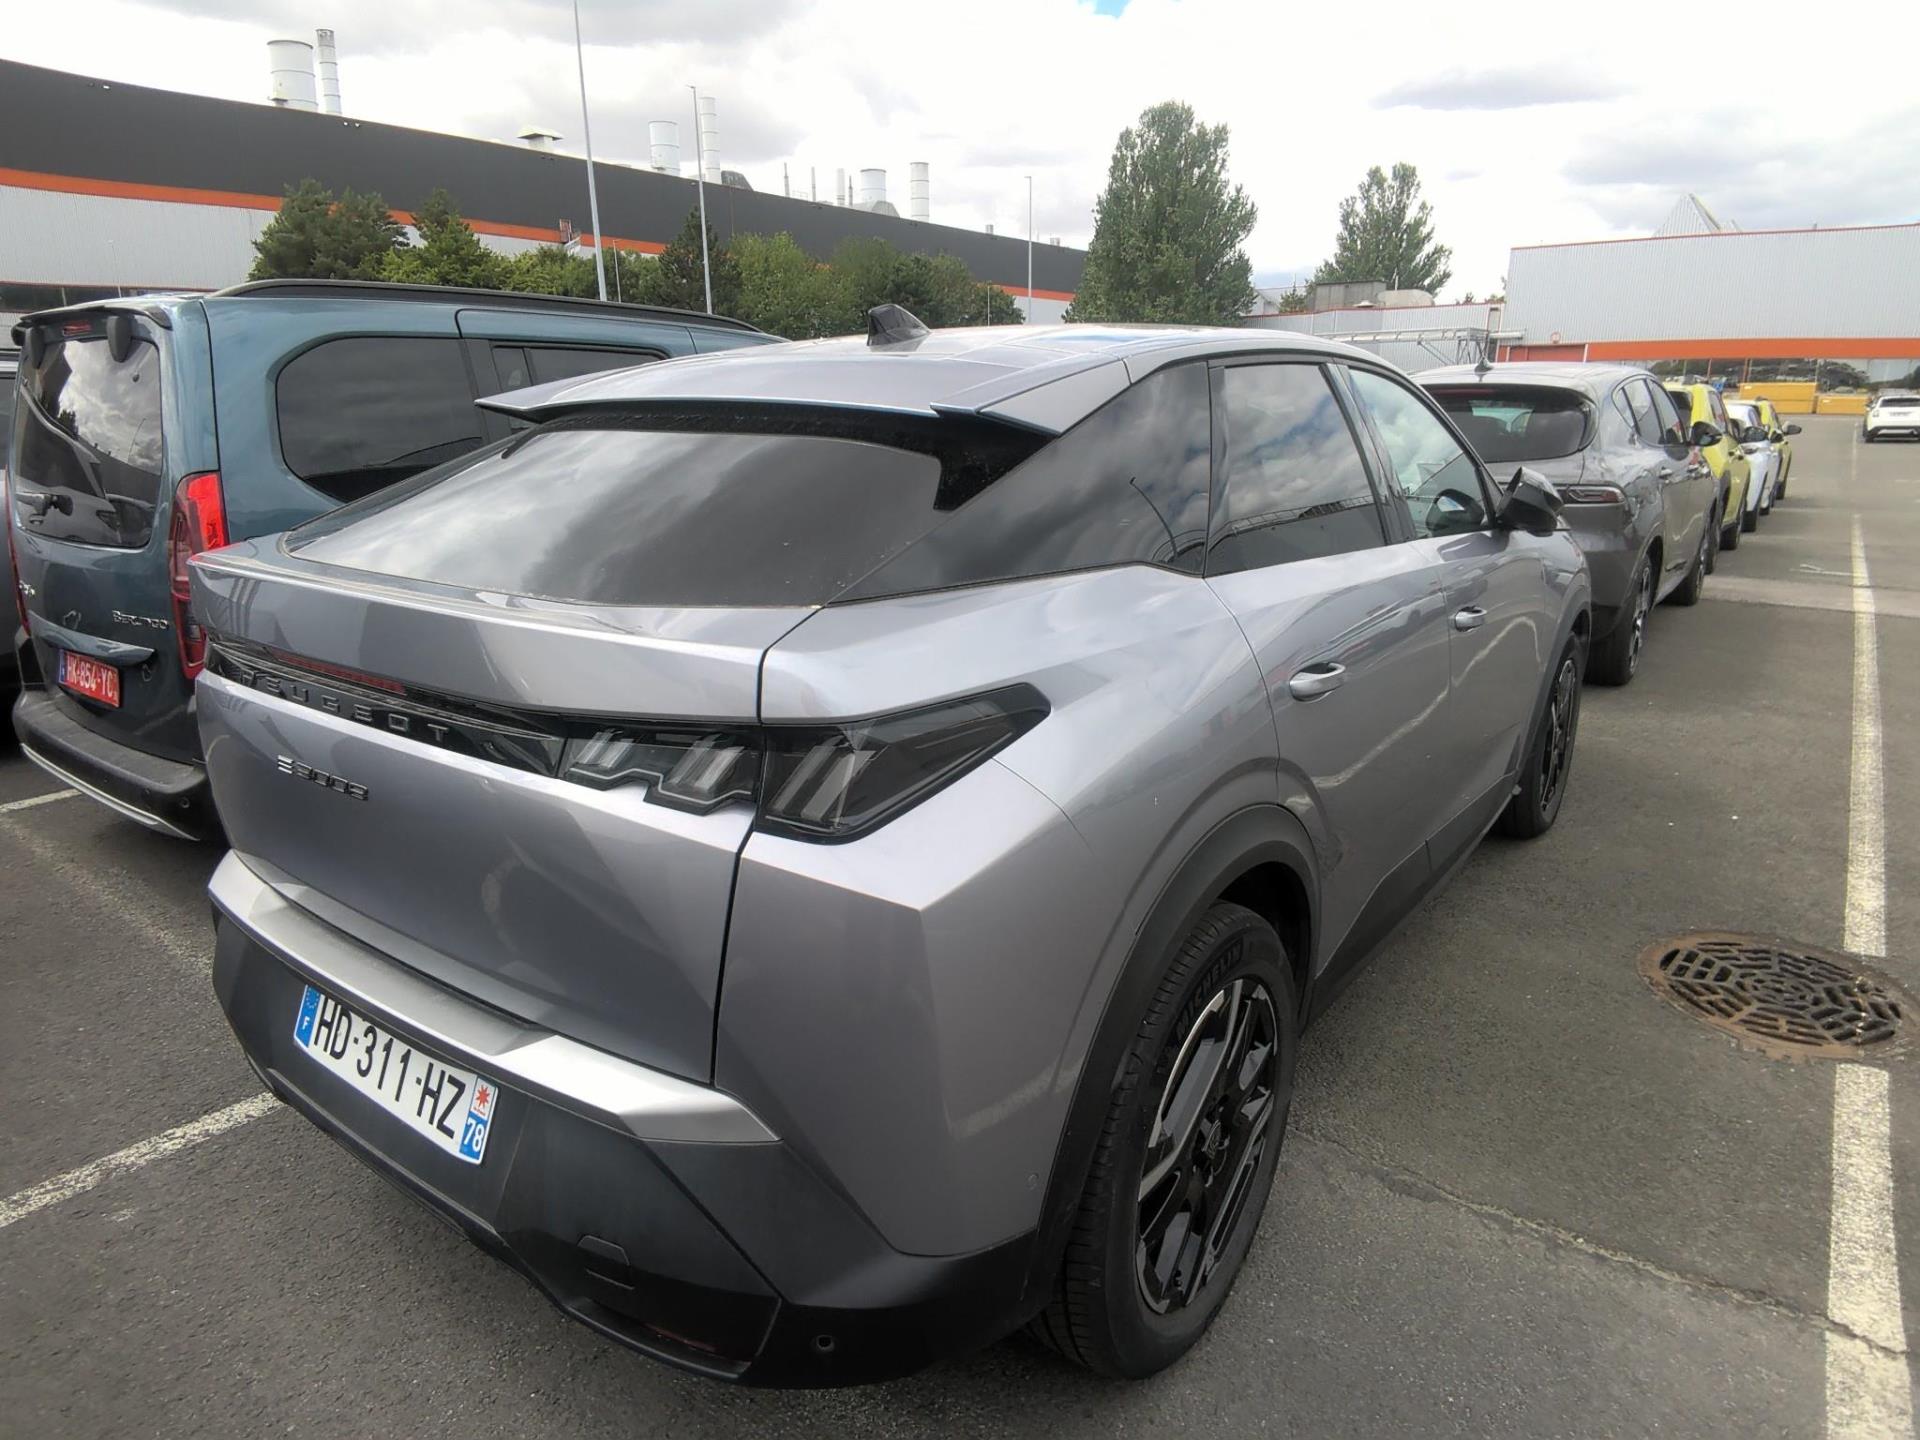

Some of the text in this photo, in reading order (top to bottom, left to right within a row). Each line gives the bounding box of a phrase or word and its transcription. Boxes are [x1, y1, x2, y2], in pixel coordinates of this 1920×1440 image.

[240, 667, 449, 742] PEUGEOT
[301, 1016, 310, 1030] F
[314, 996, 466, 1140] HD-311-HZ
[463, 1117, 485, 1152] 78
